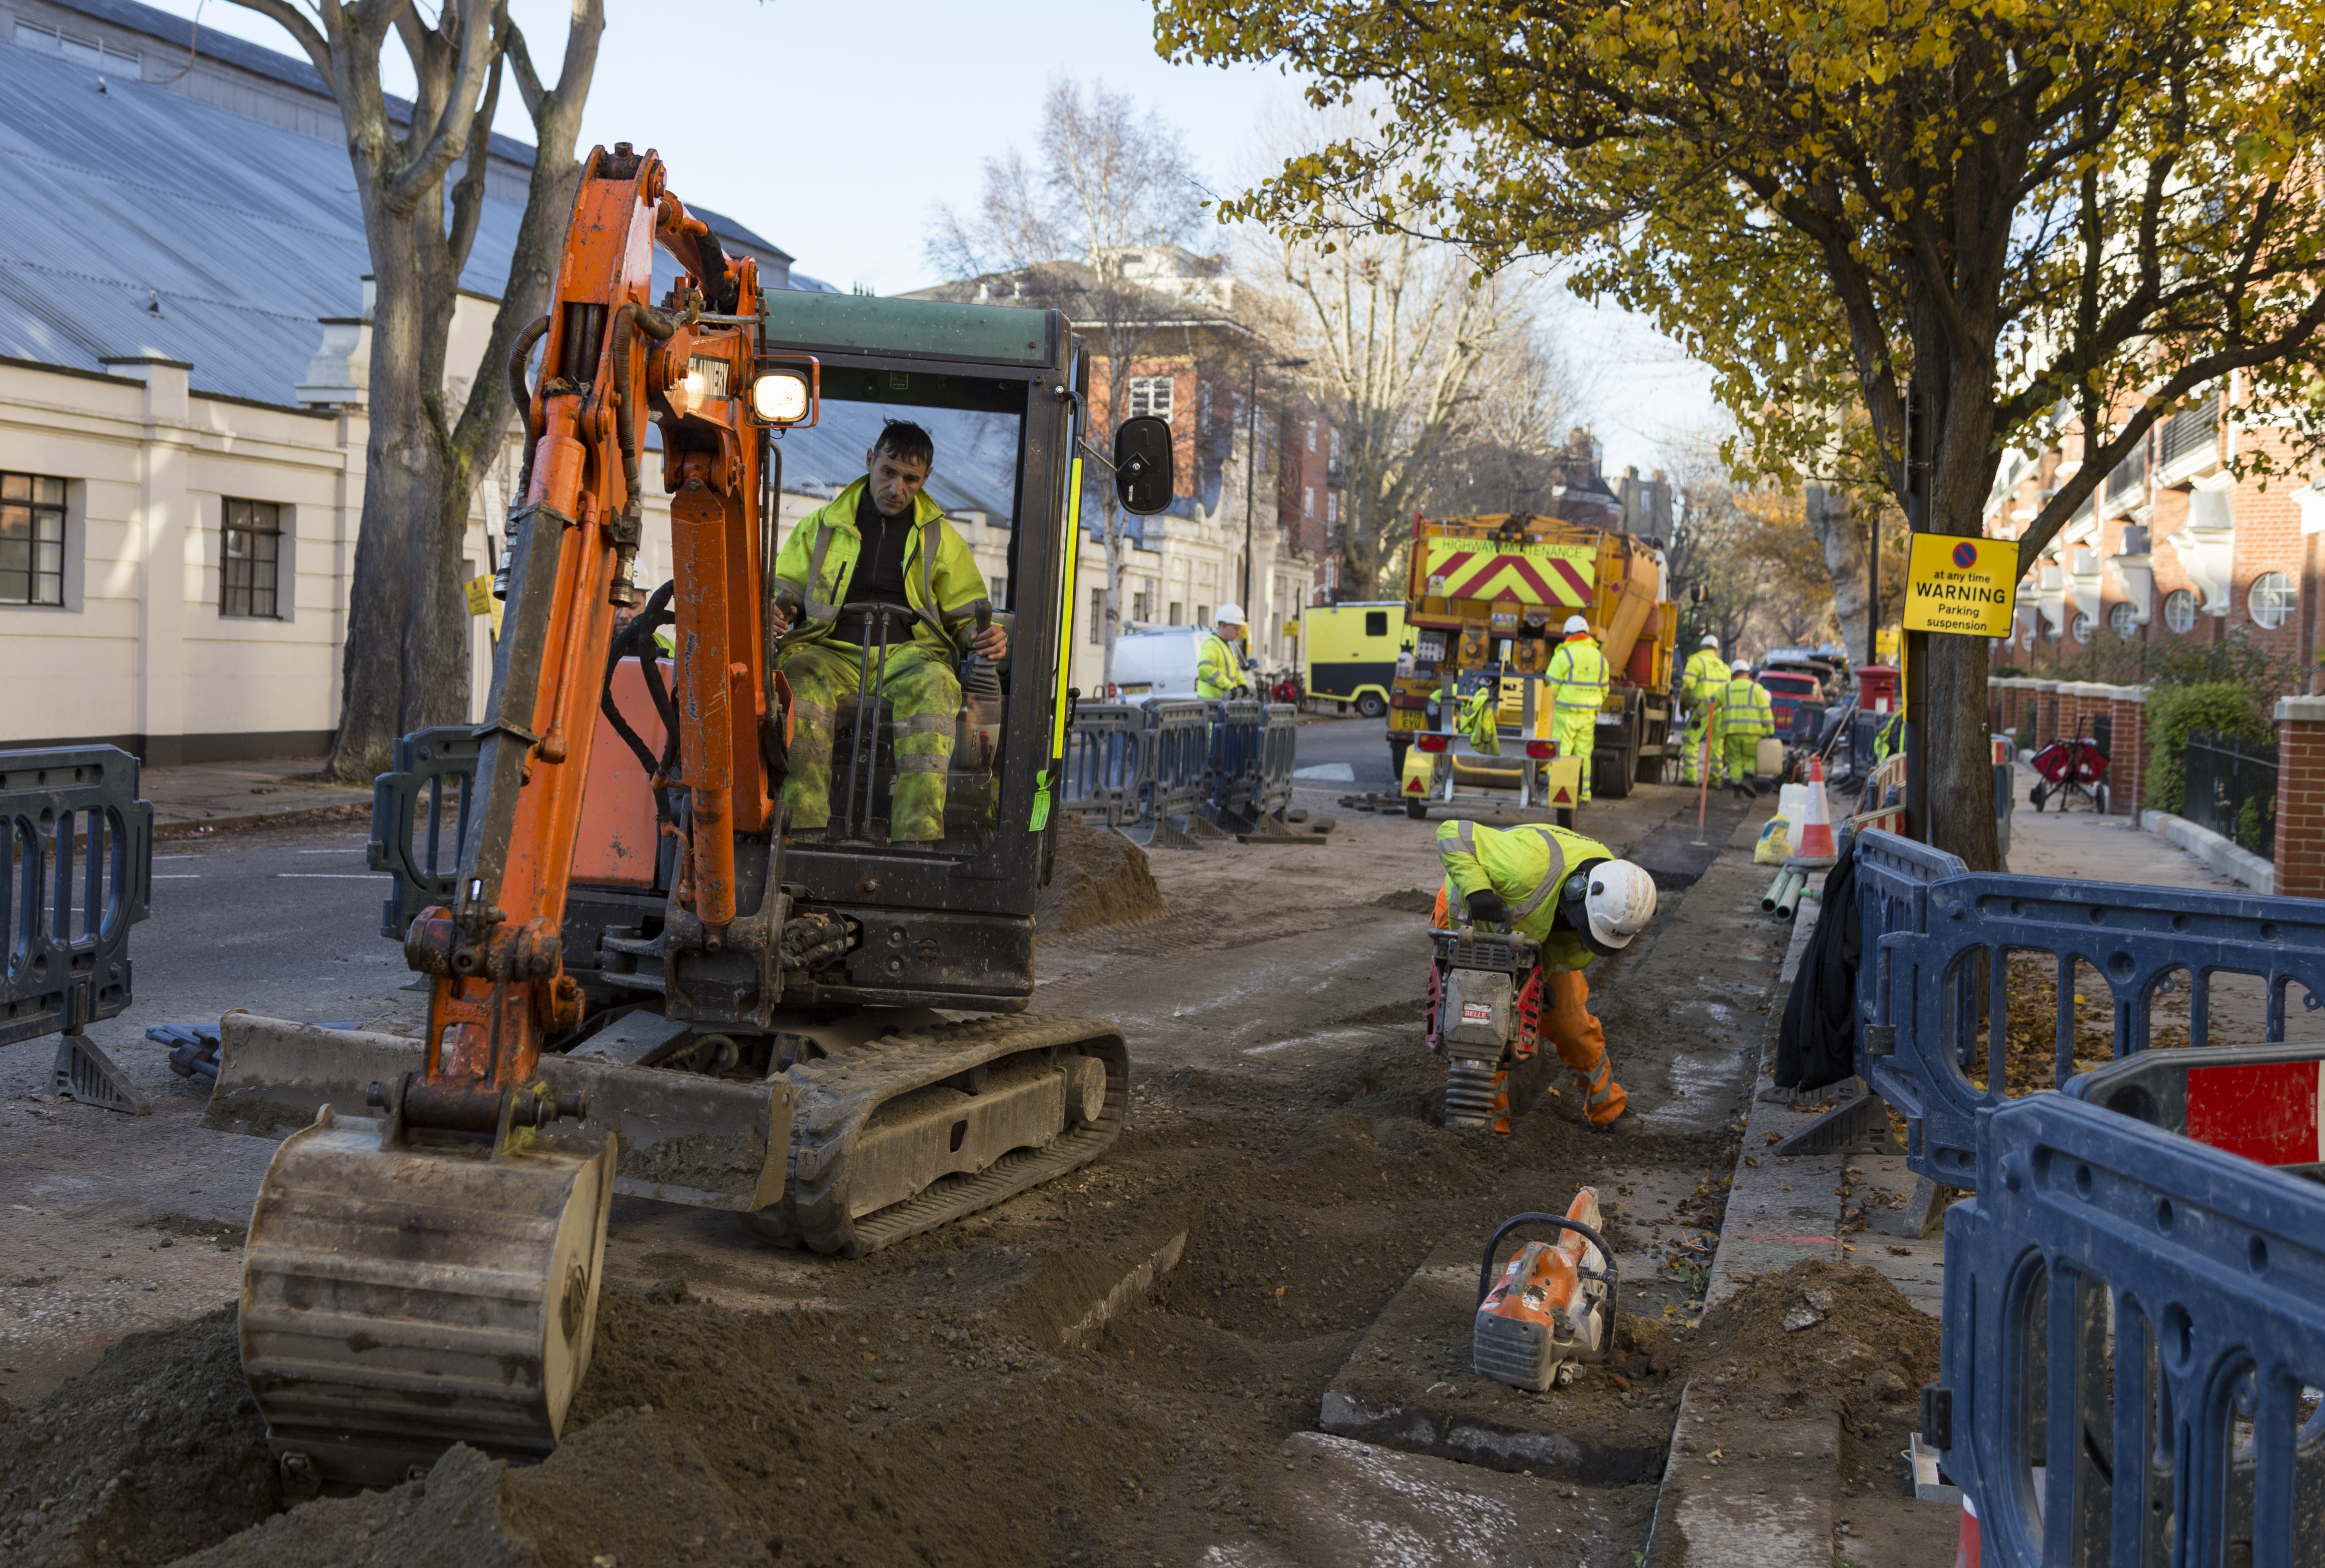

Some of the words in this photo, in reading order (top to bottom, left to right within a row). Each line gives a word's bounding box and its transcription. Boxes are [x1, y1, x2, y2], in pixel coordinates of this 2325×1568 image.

[1443, 539, 1496, 553] HIGHWAY
[1500, 542, 1583, 558] MAINTENANCE
[1934, 570, 1944, 579] at
[1947, 571, 1965, 582] any
[1968, 572, 1991, 583] time
[1916, 582, 2006, 604] WARNING
[1938, 603, 1979, 618] Parking
[1927, 618, 1987, 631] suspension
[1465, 1010, 1486, 1019] BELLE
